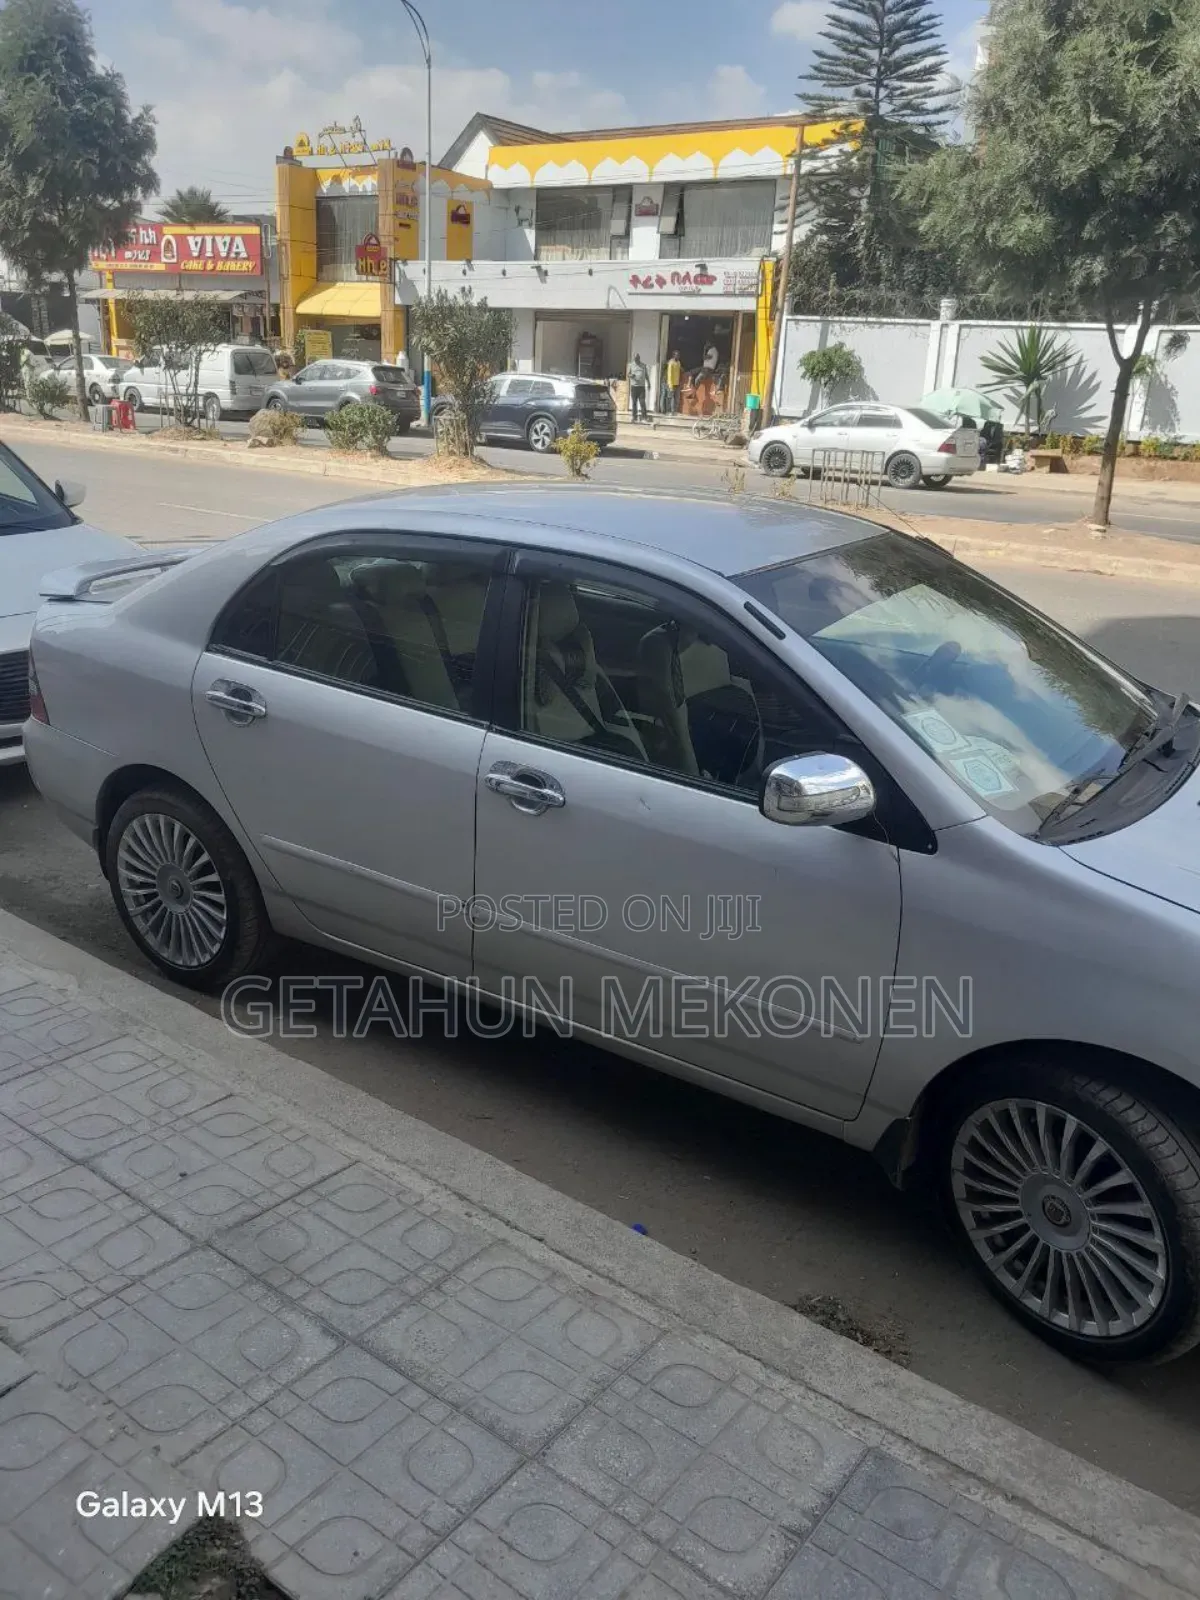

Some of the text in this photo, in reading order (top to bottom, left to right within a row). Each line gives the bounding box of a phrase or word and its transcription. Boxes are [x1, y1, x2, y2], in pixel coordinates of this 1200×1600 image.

[186, 235, 248, 258] VIVA
[180, 259, 256, 272] CAKE & BAKERY
